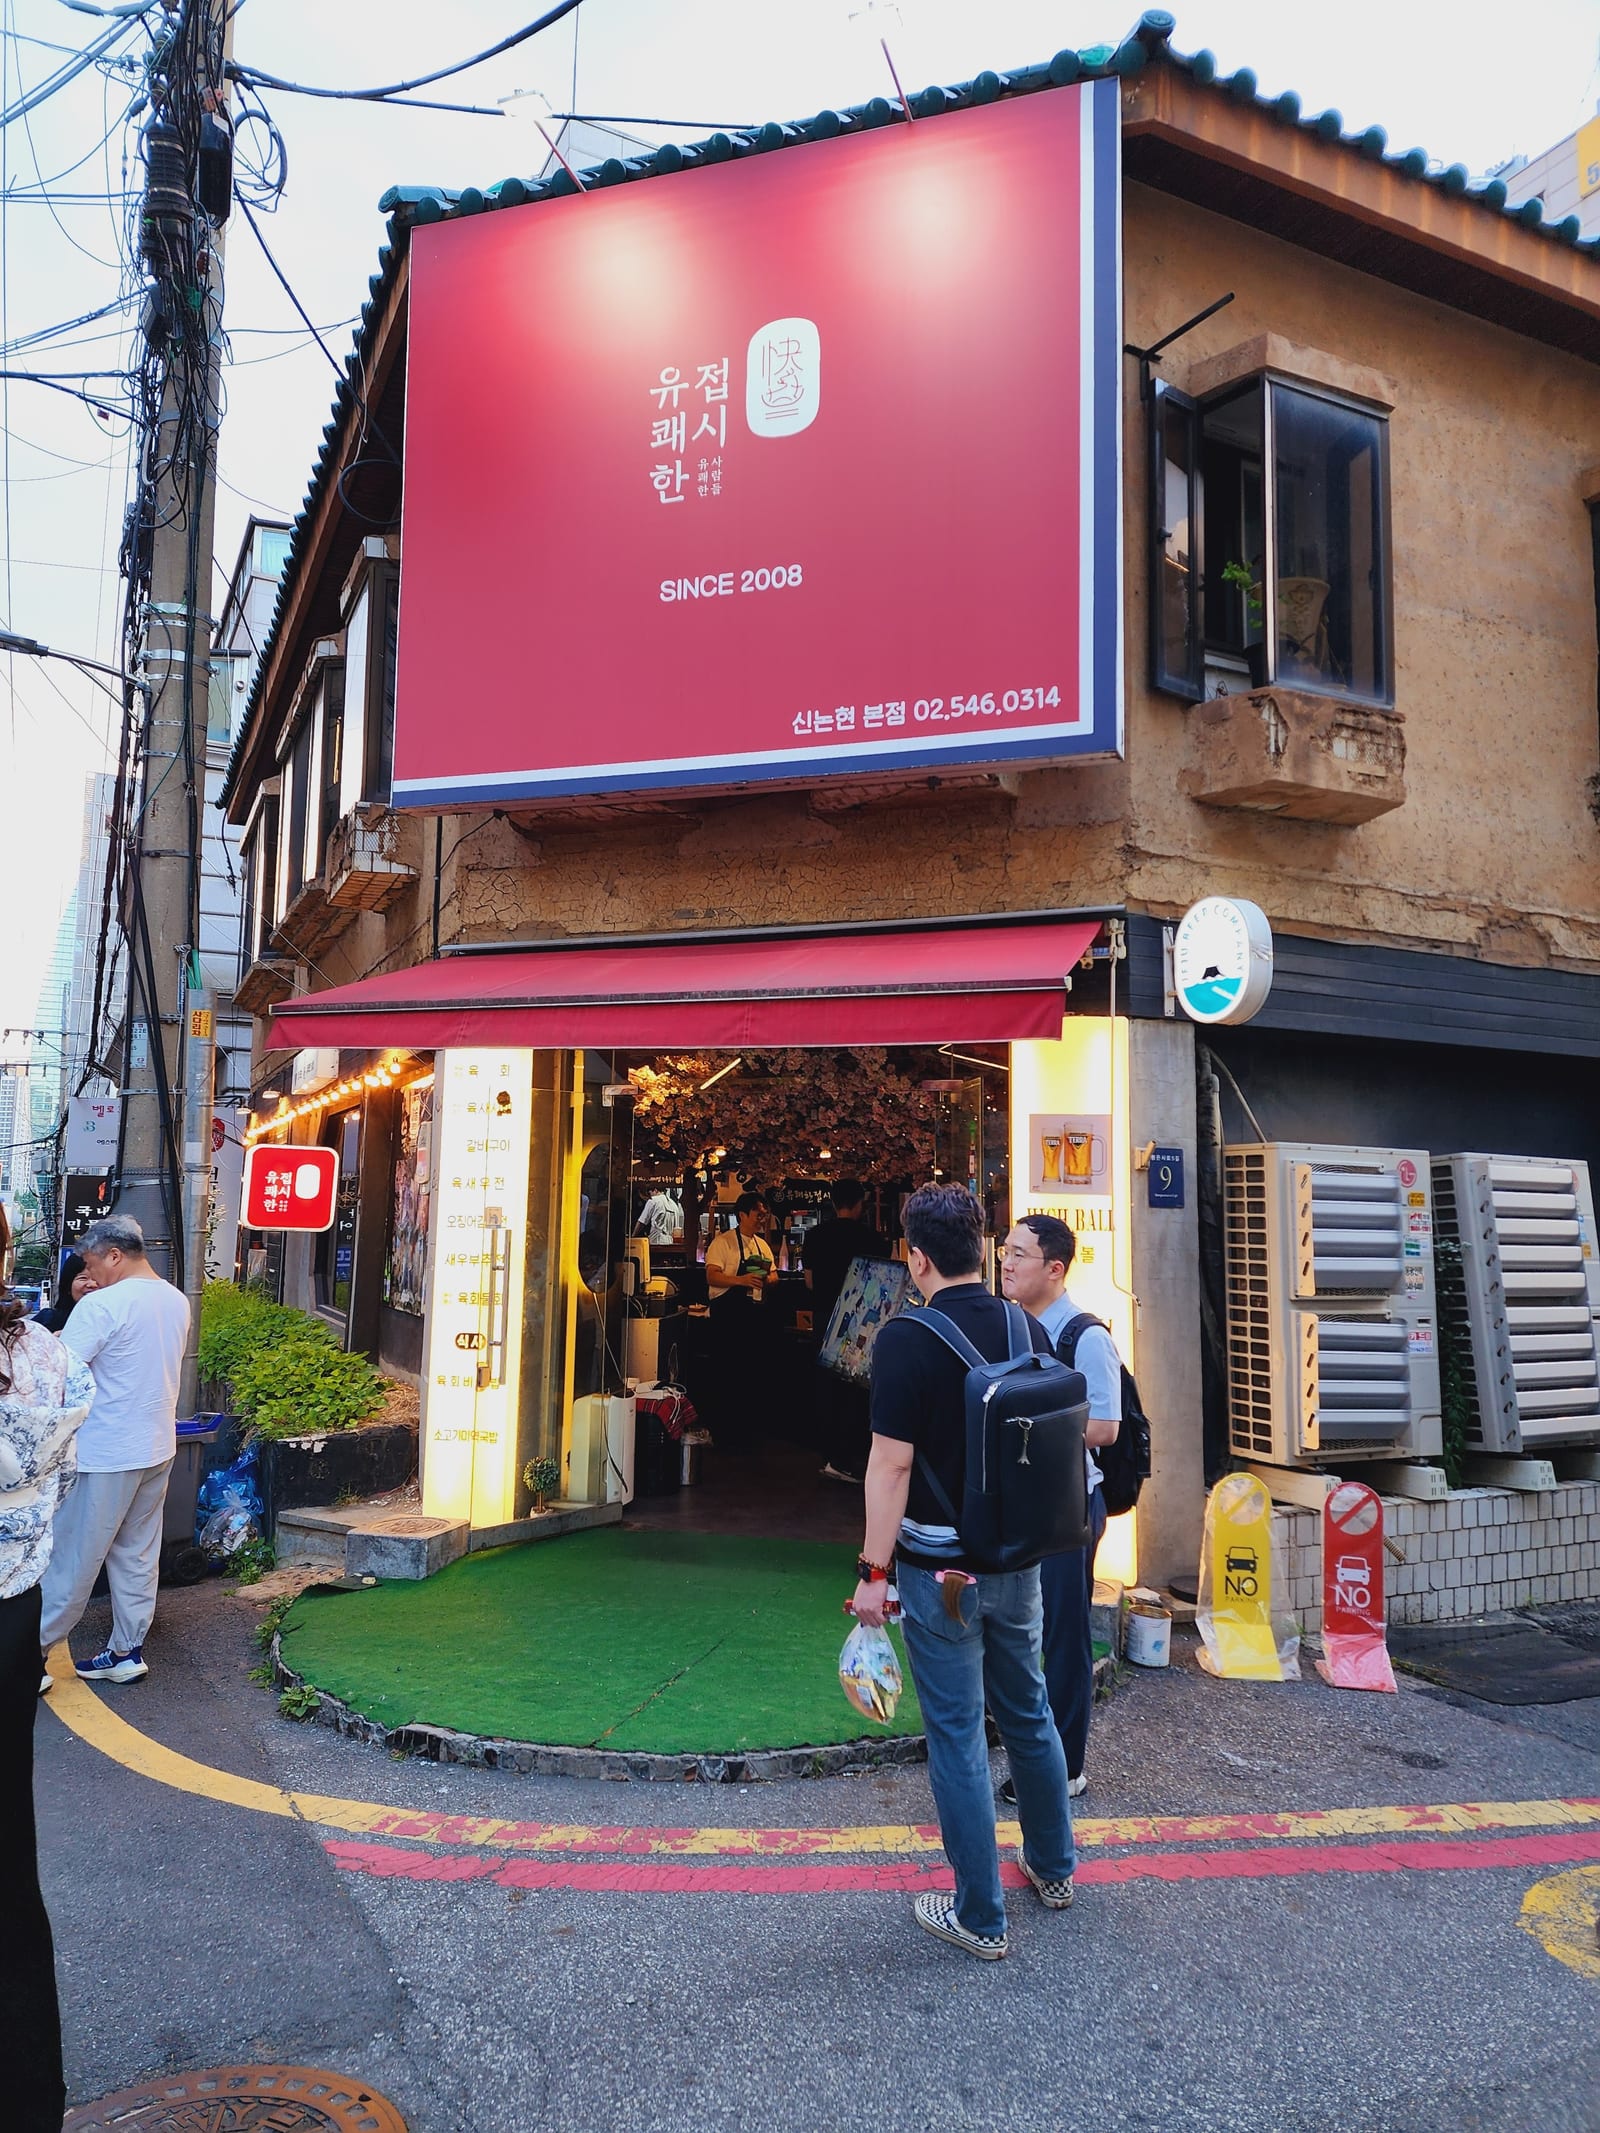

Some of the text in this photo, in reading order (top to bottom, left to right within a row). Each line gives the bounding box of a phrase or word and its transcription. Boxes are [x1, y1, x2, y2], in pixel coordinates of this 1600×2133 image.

[659, 564, 803, 602] SINCE 2008
[792, 685, 1061, 735] 신논현 본점 02.546.0314
[1160, 1166, 1171, 1190] 9
[1075, 1208, 1116, 1231] BALL
[457, 1334, 484, 1349] 식사
[437, 1376, 500, 1390] 육회비밥
[1225, 1575, 1258, 1597] NO
[1335, 1584, 1371, 1608] NO
[1335, 1606, 1371, 1616] PARKING
